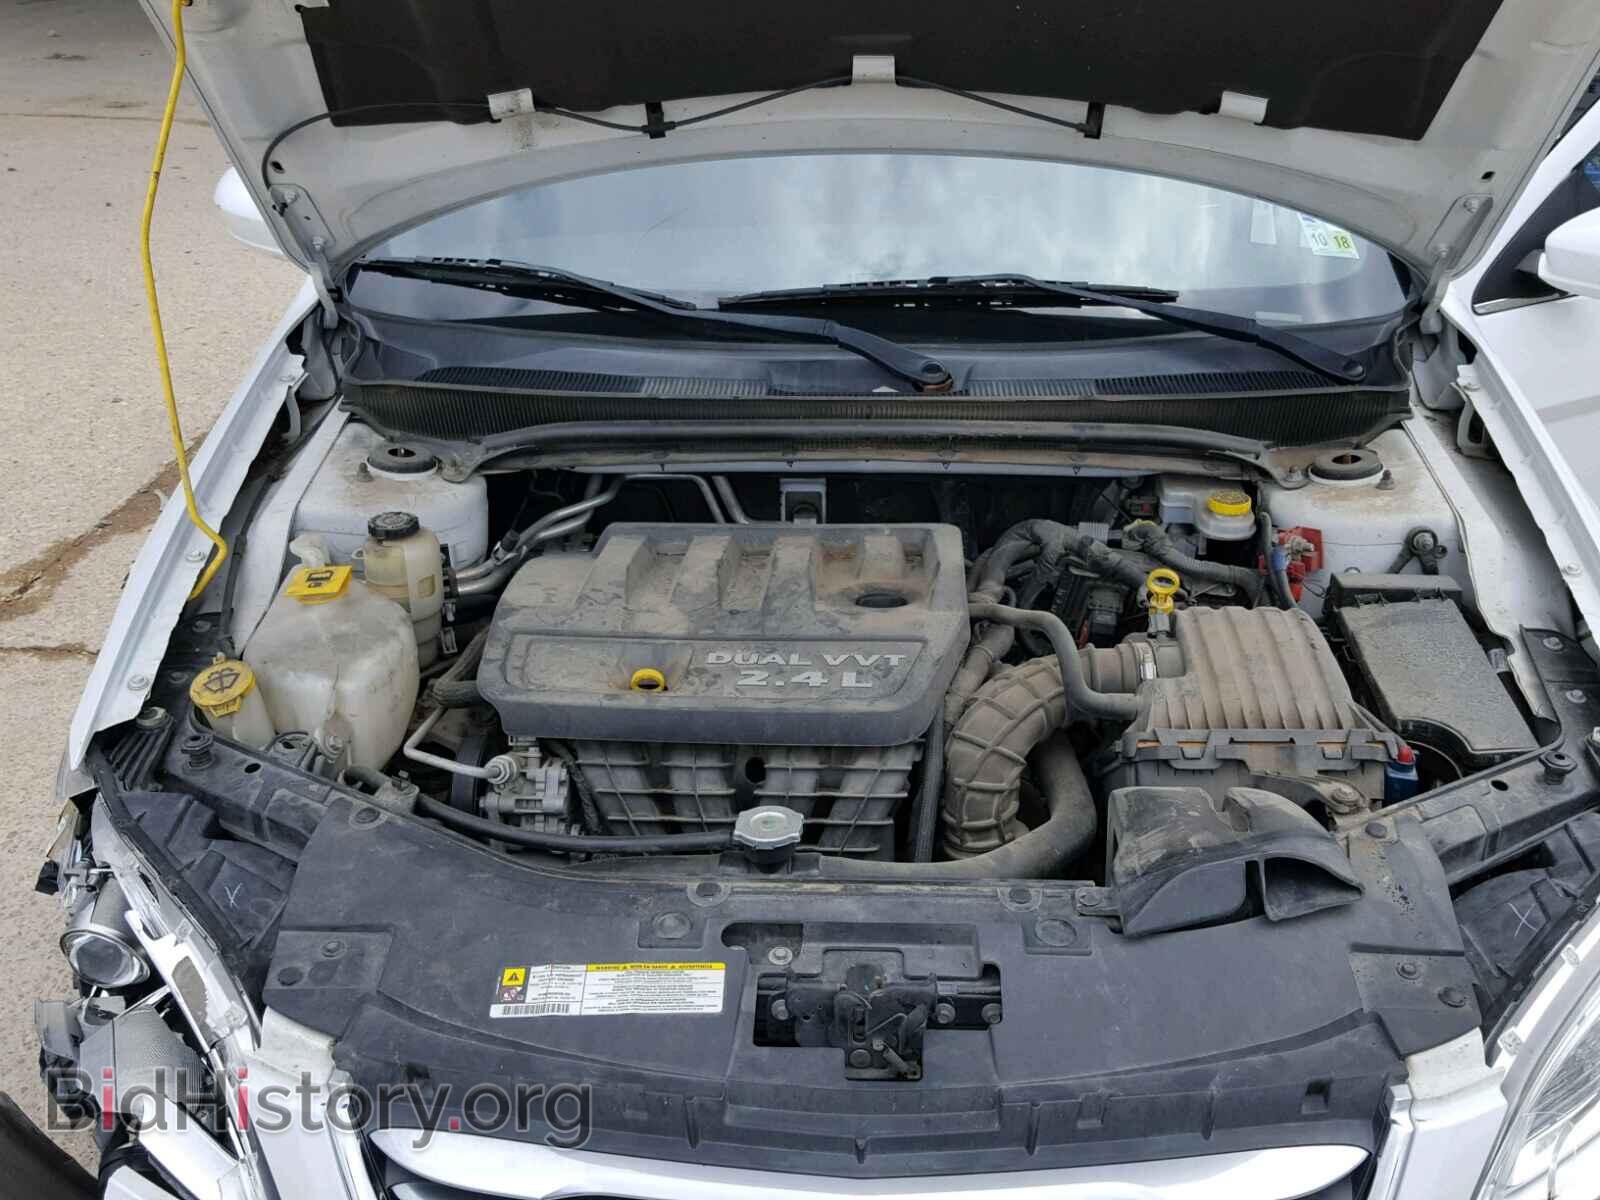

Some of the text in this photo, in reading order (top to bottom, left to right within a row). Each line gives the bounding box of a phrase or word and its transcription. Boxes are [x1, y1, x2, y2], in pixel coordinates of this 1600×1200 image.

[1312, 232, 1351, 249] 10 18
[706, 652, 905, 667] DUAL VVT
